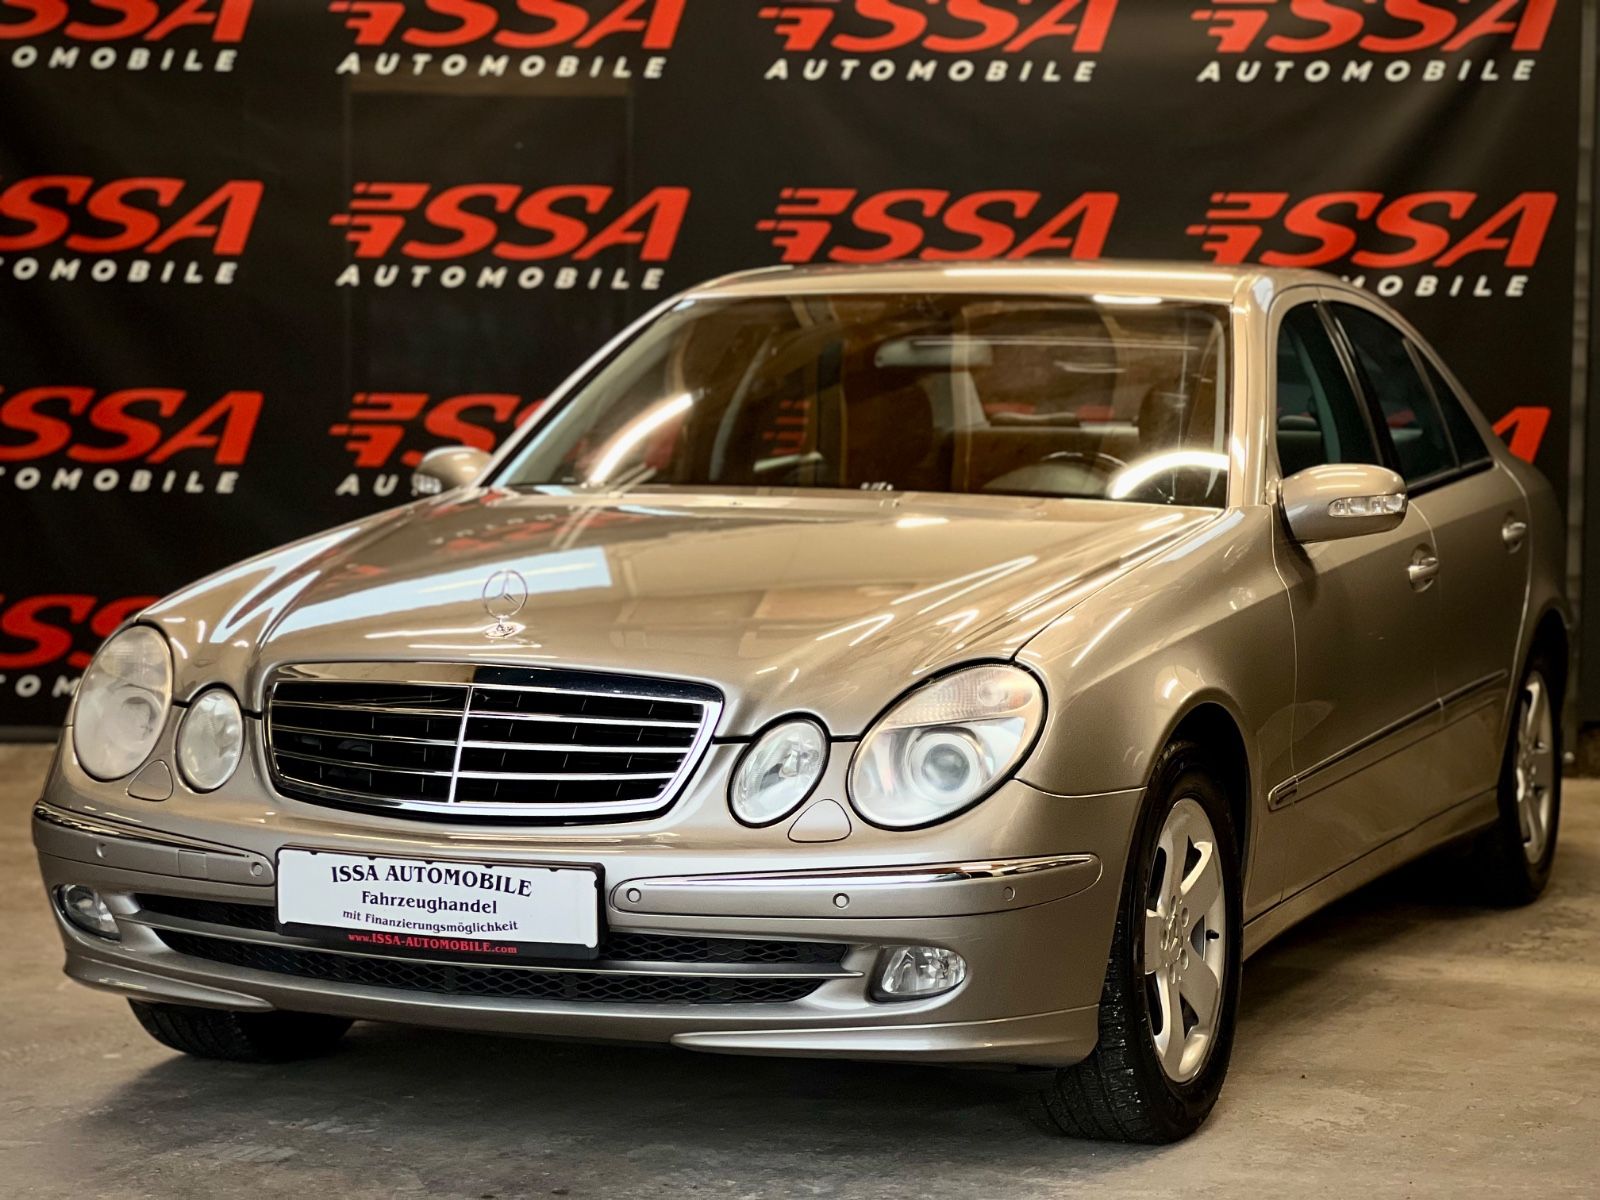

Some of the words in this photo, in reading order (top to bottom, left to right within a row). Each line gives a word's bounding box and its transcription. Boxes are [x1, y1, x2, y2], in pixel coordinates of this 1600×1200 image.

[11, 45, 238, 72] OMOBILE
[335, 52, 667, 79] AUTOMOBILE
[764, 58, 1097, 83] AUTOMOBILE
[1196, 59, 1536, 83] AUTOMOBILE
[0, 175, 264, 255] SSA
[329, 182, 691, 261] ISSA
[755, 187, 1120, 262] ISSA
[1186, 190, 1558, 270] ISSA
[0, 257, 238, 285] OMOBILE
[335, 264, 665, 290] AUTOMOBILE
[1340, 274, 1529, 298] OBILE
[0, 386, 264, 465] SSA
[329, 392, 546, 468] IS
[0, 465, 239, 494] OMOBILE
[331, 864, 379, 883] ISSA
[385, 865, 532, 897] AUTOMOBILE
[361, 890, 497, 914] Fahrzeughandel
[342, 910, 362, 921] mit
[365, 913, 519, 934] Finanzierungsmöglichkeit
[347, 932, 518, 955] www.ISSA-AUTOMOBILE.com
